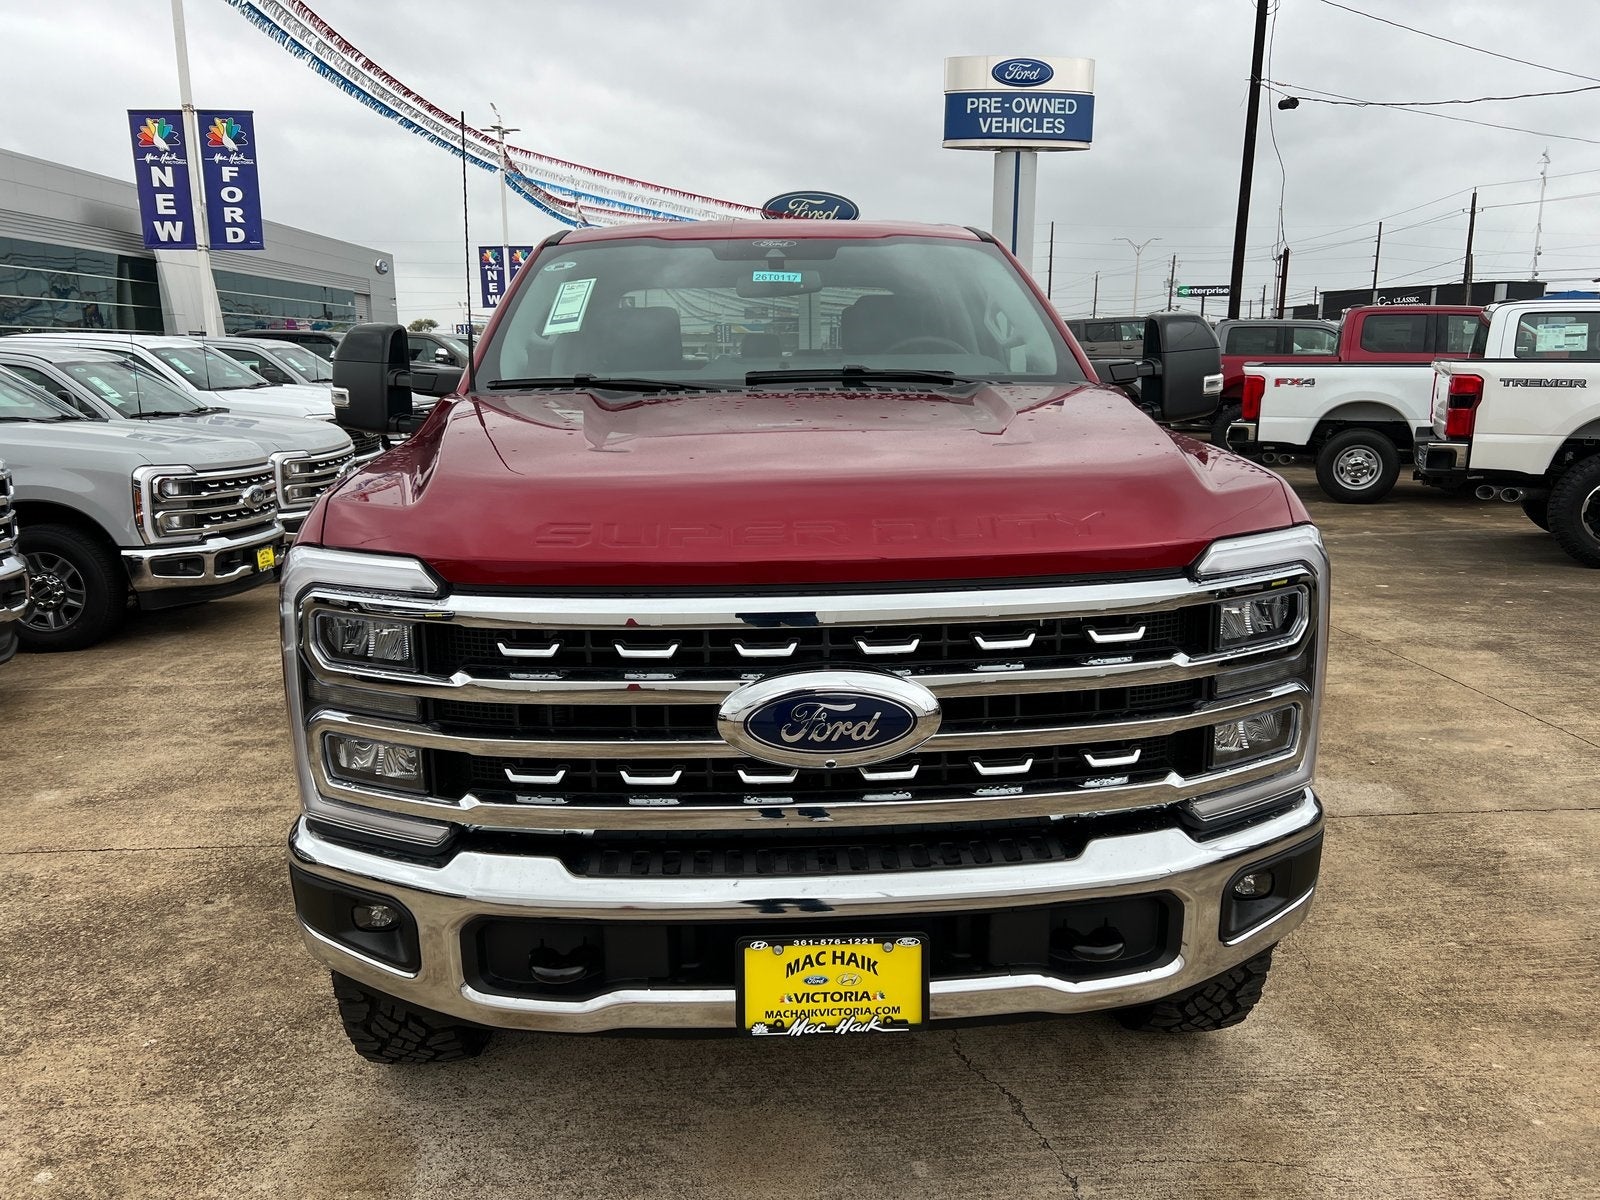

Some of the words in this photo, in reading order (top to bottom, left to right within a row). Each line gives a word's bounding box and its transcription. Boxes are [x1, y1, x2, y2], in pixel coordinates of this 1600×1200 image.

[1004, 62, 1041, 81] Ford
[966, 97, 1078, 115] PRE-OWNED
[979, 117, 1066, 134] VEHICLES
[150, 166, 183, 242] NEW
[220, 166, 246, 243] FORD
[755, 273, 798, 281] 26T0117
[487, 270, 501, 305] NEW
[1180, 287, 1230, 295] enterprise
[1274, 377, 1316, 388] FX4
[1499, 378, 1587, 388] TREMOR
[533, 521, 850, 548] SUPER
[871, 511, 1105, 545] DUTY
[780, 702, 882, 743] Ford
[793, 938, 875, 946] 361-576-1221
[785, 951, 826, 979] MAC
[831, 951, 879, 976] HAIK
[806, 977, 825, 985] Ford
[794, 991, 872, 1004] VICTORIA
[765, 1006, 900, 1019] MACHAIKVICTORIA.COM
[786, 1017, 834, 1037] Mac
[835, 1015, 894, 1035] Haik
